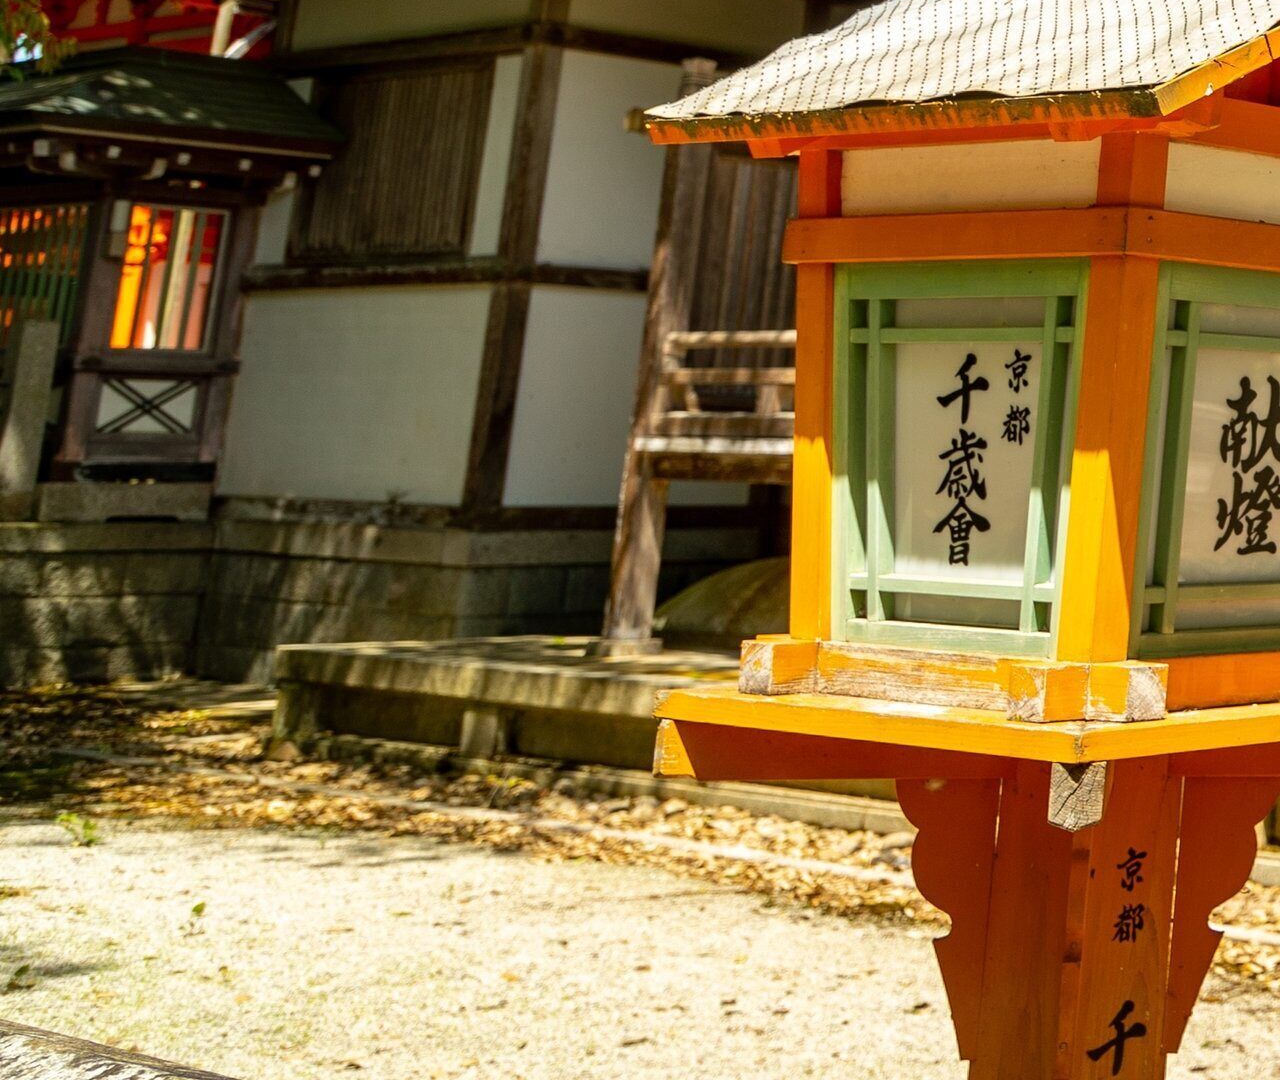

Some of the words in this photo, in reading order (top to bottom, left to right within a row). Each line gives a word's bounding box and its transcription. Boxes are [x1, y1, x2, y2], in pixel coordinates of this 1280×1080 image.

[1000, 349, 1032, 446] 京都
[1111, 847, 1147, 943] 京都
[1086, 999, 1147, 1077] 千
